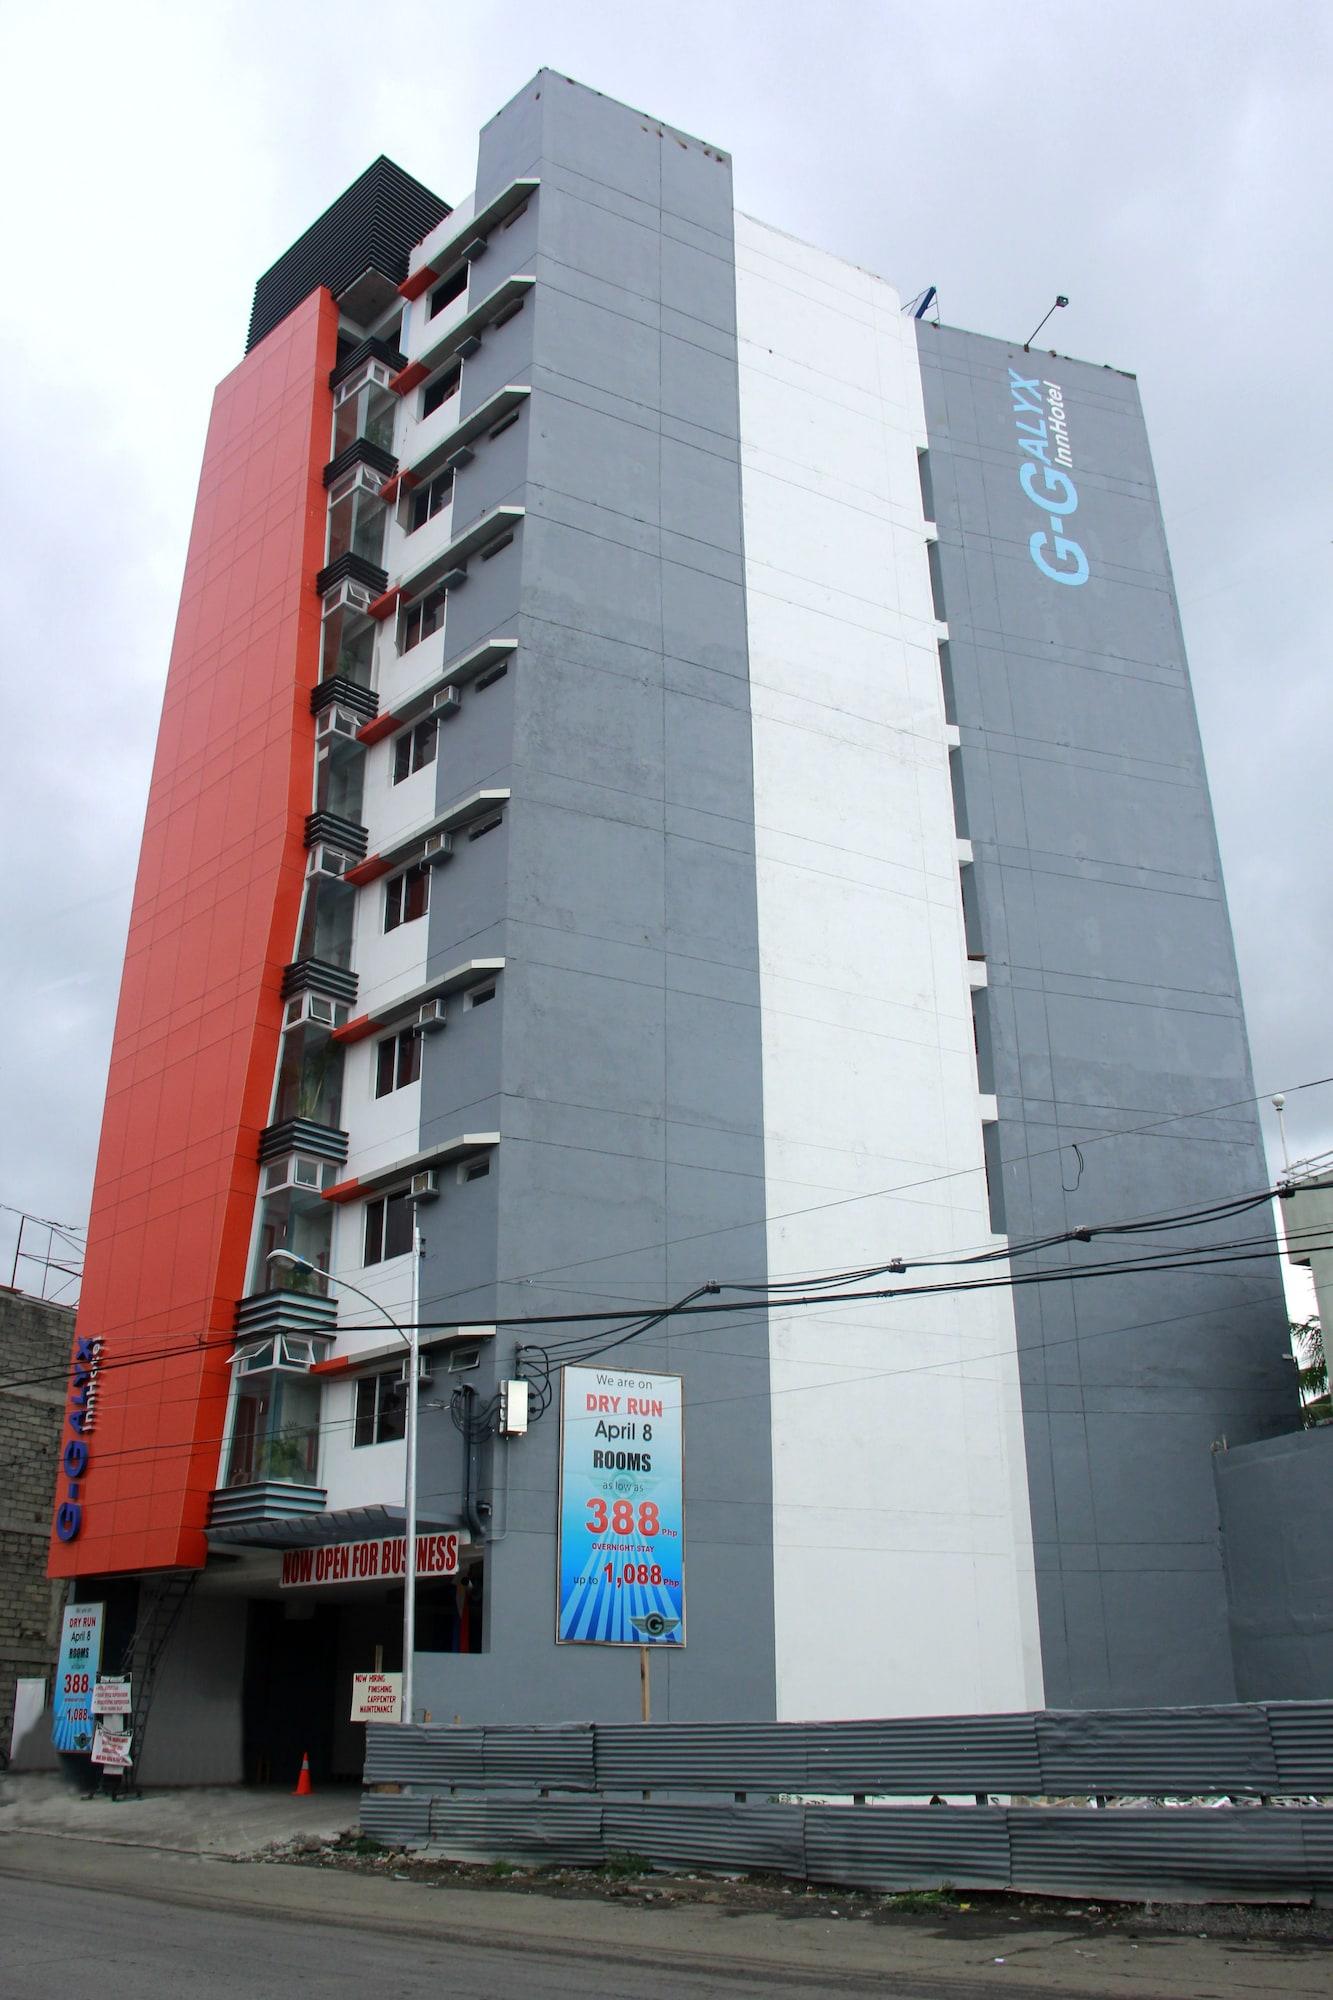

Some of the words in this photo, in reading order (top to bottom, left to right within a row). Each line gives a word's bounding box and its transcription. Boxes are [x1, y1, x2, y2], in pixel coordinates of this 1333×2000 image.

[1043, 379, 1073, 468] InnHotel
[1008, 367, 1090, 586] G-GALYX
[596, 1374, 615, 1386] We
[617, 1378, 635, 1389] are
[638, 1381, 653, 1390] on
[586, 1393, 621, 1413] DRY
[627, 1397, 663, 1417] RUN
[56, 1337, 94, 1542] G-GALYX
[595, 1420, 635, 1442] April
[642, 1423, 653, 1442] 8
[593, 1449, 652, 1472] ROOMS
[602, 1482, 613, 1491] as
[615, 1481, 632, 1491] low
[633, 1483, 644, 1493] as
[586, 1497, 660, 1537] 388
[661, 1528, 678, 1538] Php
[592, 1542, 635, 1552] OVERNIGHT
[636, 1545, 655, 1553] STAY
[282, 1550, 314, 1584] NOW
[315, 1546, 349, 1582] OPEN
[352, 1542, 379, 1577] FOR
[573, 1577, 586, 1587] up
[588, 1576, 599, 1585] to
[603, 1562, 662, 1589] 1,088
[663, 1578, 680, 1588] Php
[69, 1617, 81, 1628] DRY
[83, 1616, 96, 1627] RUN
[71, 1631, 86, 1643] April
[64, 1674, 89, 1693] 388
